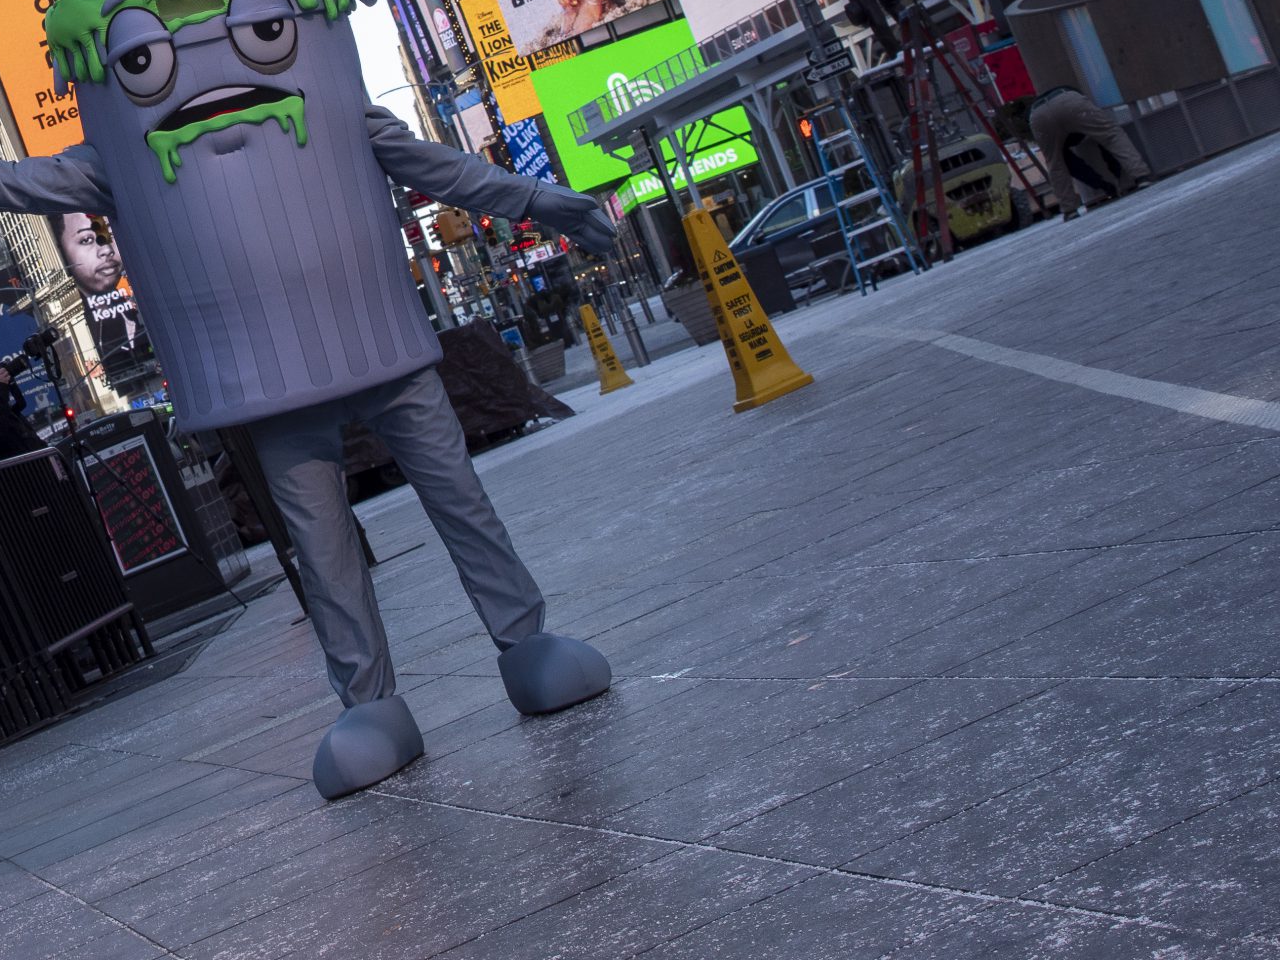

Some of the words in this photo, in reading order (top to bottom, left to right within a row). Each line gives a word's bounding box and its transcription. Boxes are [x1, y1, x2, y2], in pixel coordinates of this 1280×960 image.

[439, 29, 454, 42] TACO
[478, 19, 503, 36] THE
[443, 39, 458, 51] BELL
[479, 34, 514, 58] LION
[485, 54, 527, 84] KING
[830, 57, 847, 71] WAY
[32, 105, 79, 131] Take
[513, 141, 543, 172] MAMA
[521, 151, 550, 177] AKES
[631, 171, 666, 198] LIN
[713, 259, 735, 275] CAUTION
[86, 287, 128, 309] Keyon
[725, 293, 751, 311] SAFETY
[91, 298, 133, 323] Keyon
[732, 303, 753, 319] FIRST
[744, 319, 755, 329] LA
